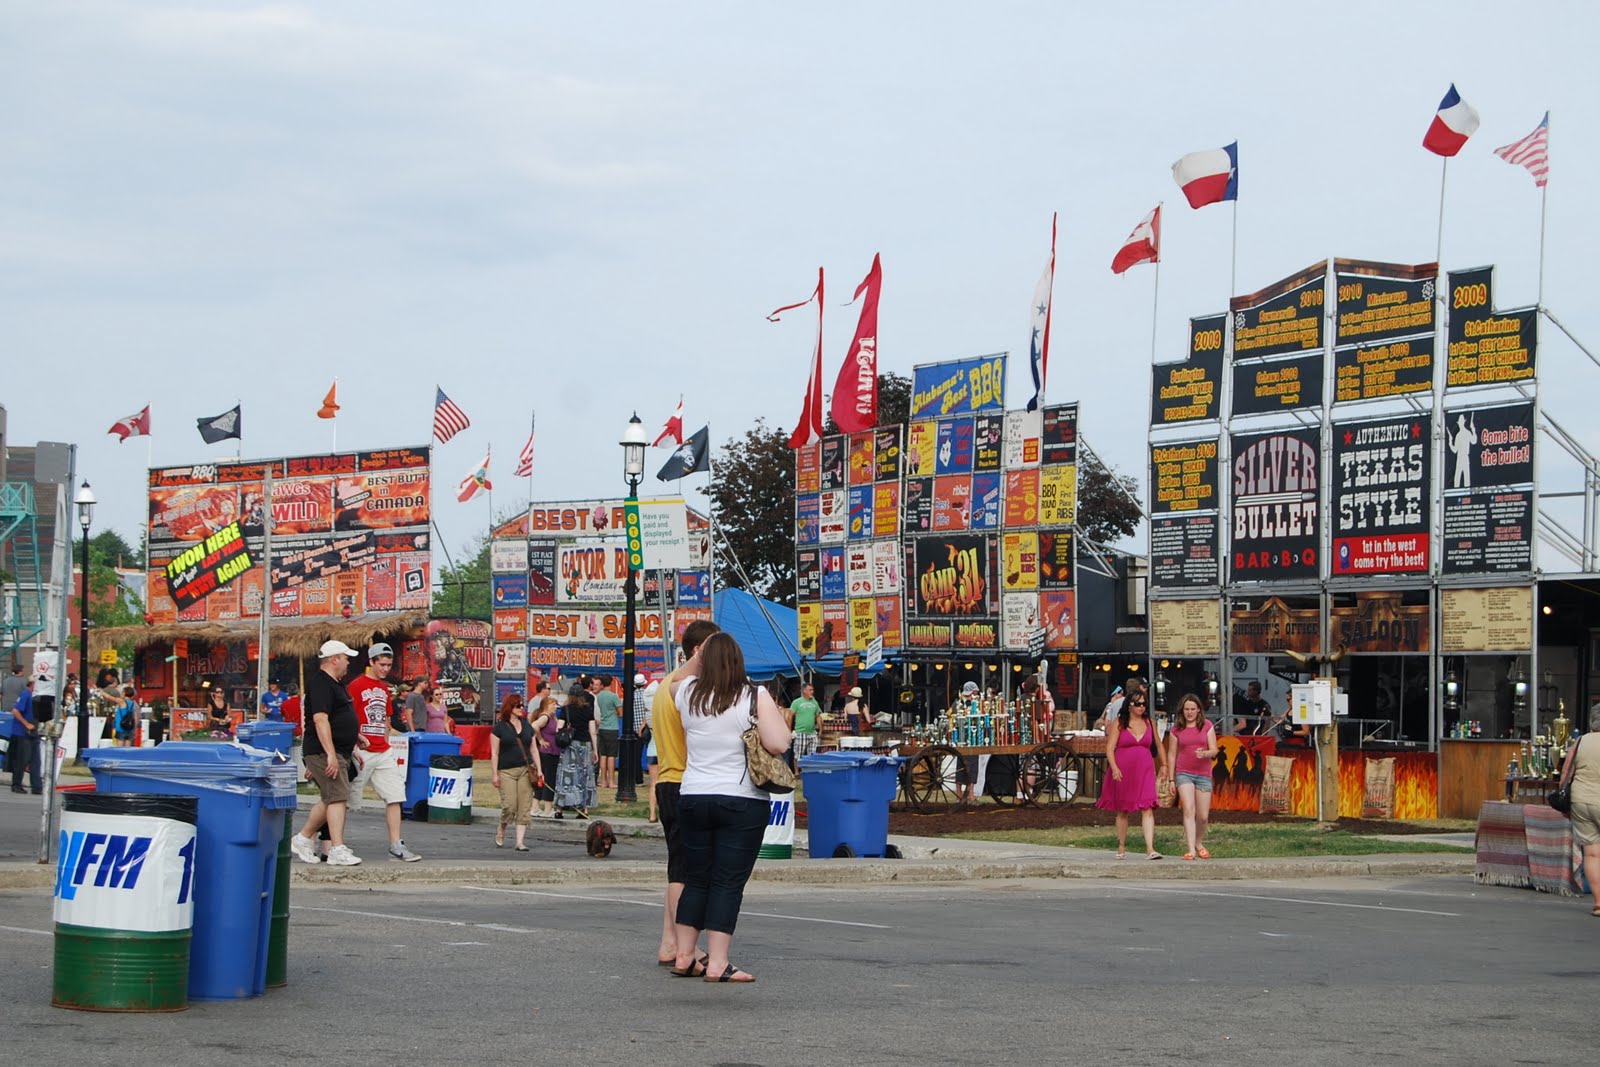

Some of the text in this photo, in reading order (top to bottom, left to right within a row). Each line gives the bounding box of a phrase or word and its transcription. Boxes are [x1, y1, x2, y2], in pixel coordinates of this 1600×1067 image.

[1300, 289, 1323, 308] 2010
[1339, 283, 1362, 302] 2010
[1454, 283, 1487, 309] 2009
[1194, 329, 1221, 351] 2009
[1458, 341, 1478, 355] Place
[1479, 338, 1496, 353] BEST
[1496, 335, 1520, 350] SAUCE
[1458, 356, 1477, 369] Place
[1478, 352, 1496, 367] BEST
[1496, 348, 1528, 365] CHICKEN
[969, 358, 1003, 410] BBQ
[1458, 370, 1477, 384] Place
[1478, 367, 1496, 381] BEST
[1496, 365, 1513, 380] RIBS
[912, 368, 964, 415] Alabama's
[941, 383, 968, 415] Best
[1355, 423, 1409, 445] AUTHENTIC
[1481, 425, 1529, 446] Come bite
[1235, 436, 1317, 496] SILVER
[1339, 443, 1424, 488] TEXAS
[1481, 449, 1498, 467] the
[192, 465, 215, 482] BBQ
[368, 473, 428, 487] BEST BUTT
[262, 482, 311, 497] aWGs
[1042, 484, 1057, 499] BBQ
[271, 501, 319, 523] WILD
[366, 495, 425, 511] CANADA
[1057, 508, 1074, 519] RIBS
[1339, 487, 1422, 530] STYLE
[533, 508, 590, 530] BEST
[1234, 502, 1316, 540] BULLET
[206, 522, 241, 554] HERE
[644, 530, 672, 538] displayed
[1362, 538, 1417, 553] 1st in the west
[201, 549, 222, 569] LAST
[216, 552, 251, 584] AGAIN
[371, 559, 390, 571] MENU
[562, 547, 606, 580] GATOR
[1354, 551, 1425, 570] come try the best!
[921, 547, 982, 604] CAMP 31
[532, 613, 580, 638] BEST
[1232, 622, 1319, 636] SHERIFF'S OFFICE
[1340, 619, 1419, 648] SALOON
[1264, 638, 1284, 650] JAIL
[464, 647, 493, 670] WILD
[531, 647, 571, 665] FLORIDA'S
[571, 648, 597, 666] FINEST
[597, 648, 616, 667] RIBS
[177, 836, 195, 904] 1
